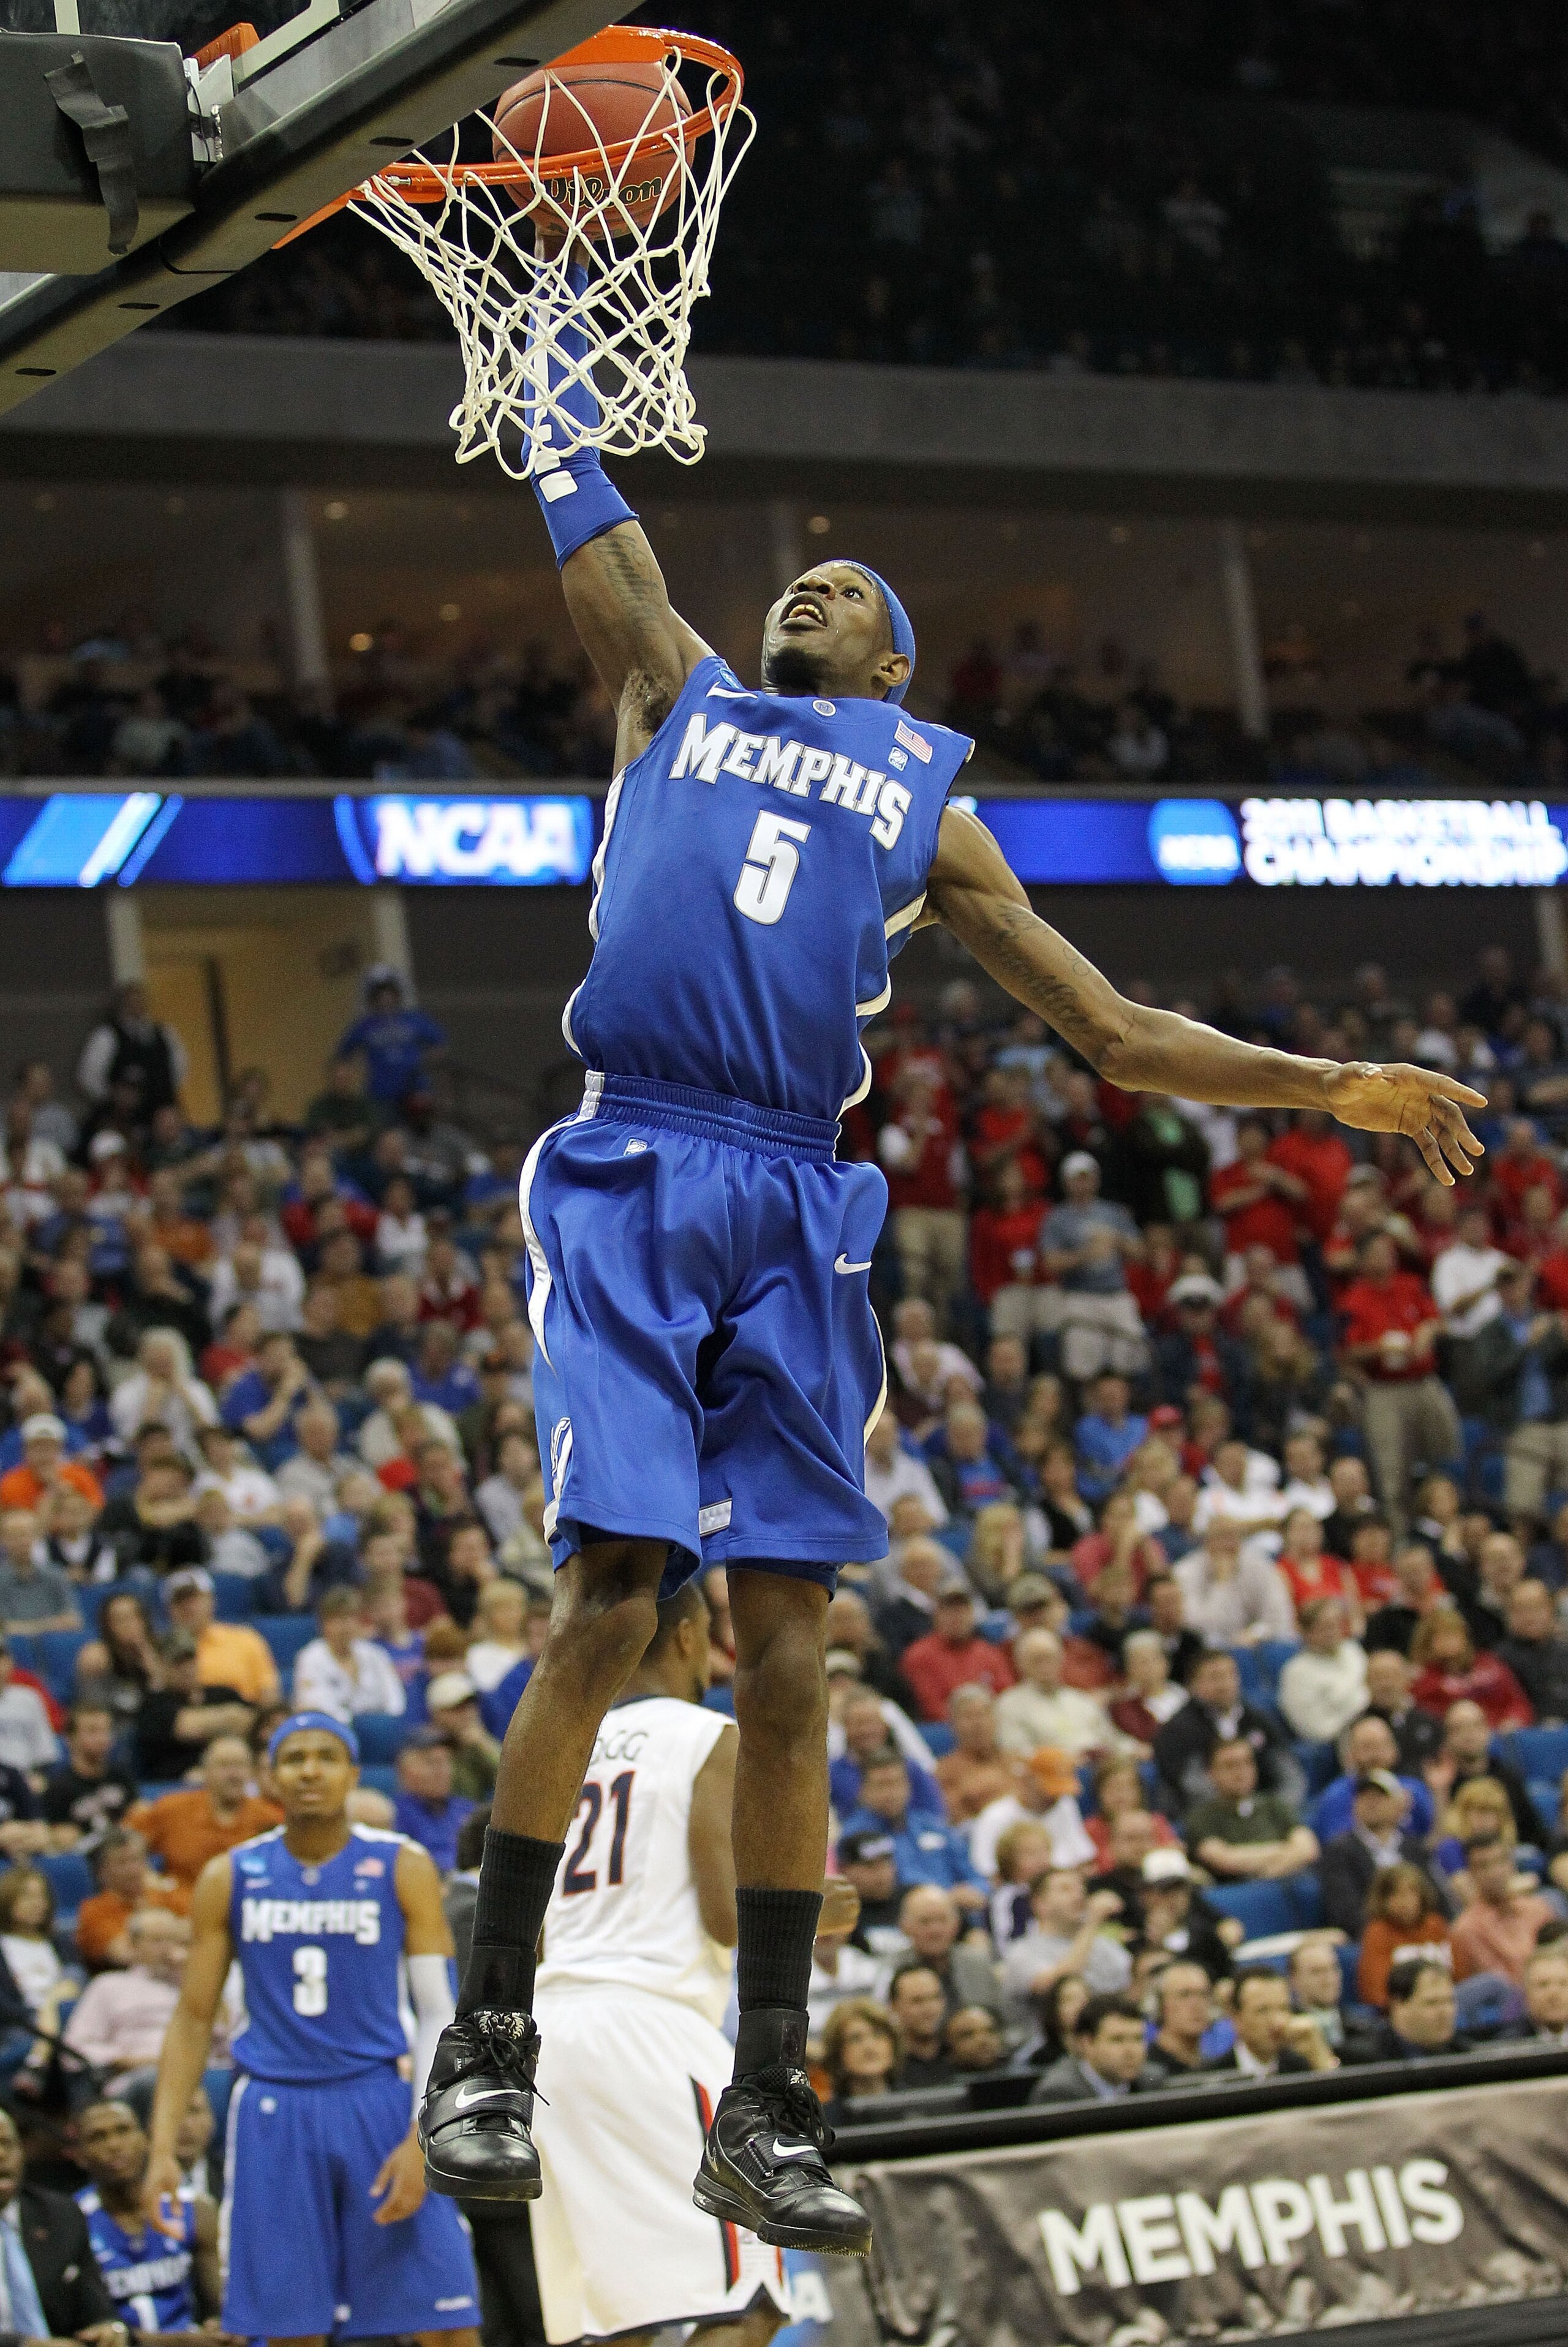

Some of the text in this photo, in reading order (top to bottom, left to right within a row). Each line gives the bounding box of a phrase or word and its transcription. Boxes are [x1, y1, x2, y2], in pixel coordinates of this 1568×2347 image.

[375, 802, 576, 877] NCAA
[668, 713, 913, 851] MEMPHIS
[733, 809, 812, 925] 5
[563, 1769, 636, 1897] 21
[241, 1899, 381, 1945] MEMPHIS
[292, 1945, 328, 2017] 3
[1039, 2158, 1465, 2296] MEMPHIS
